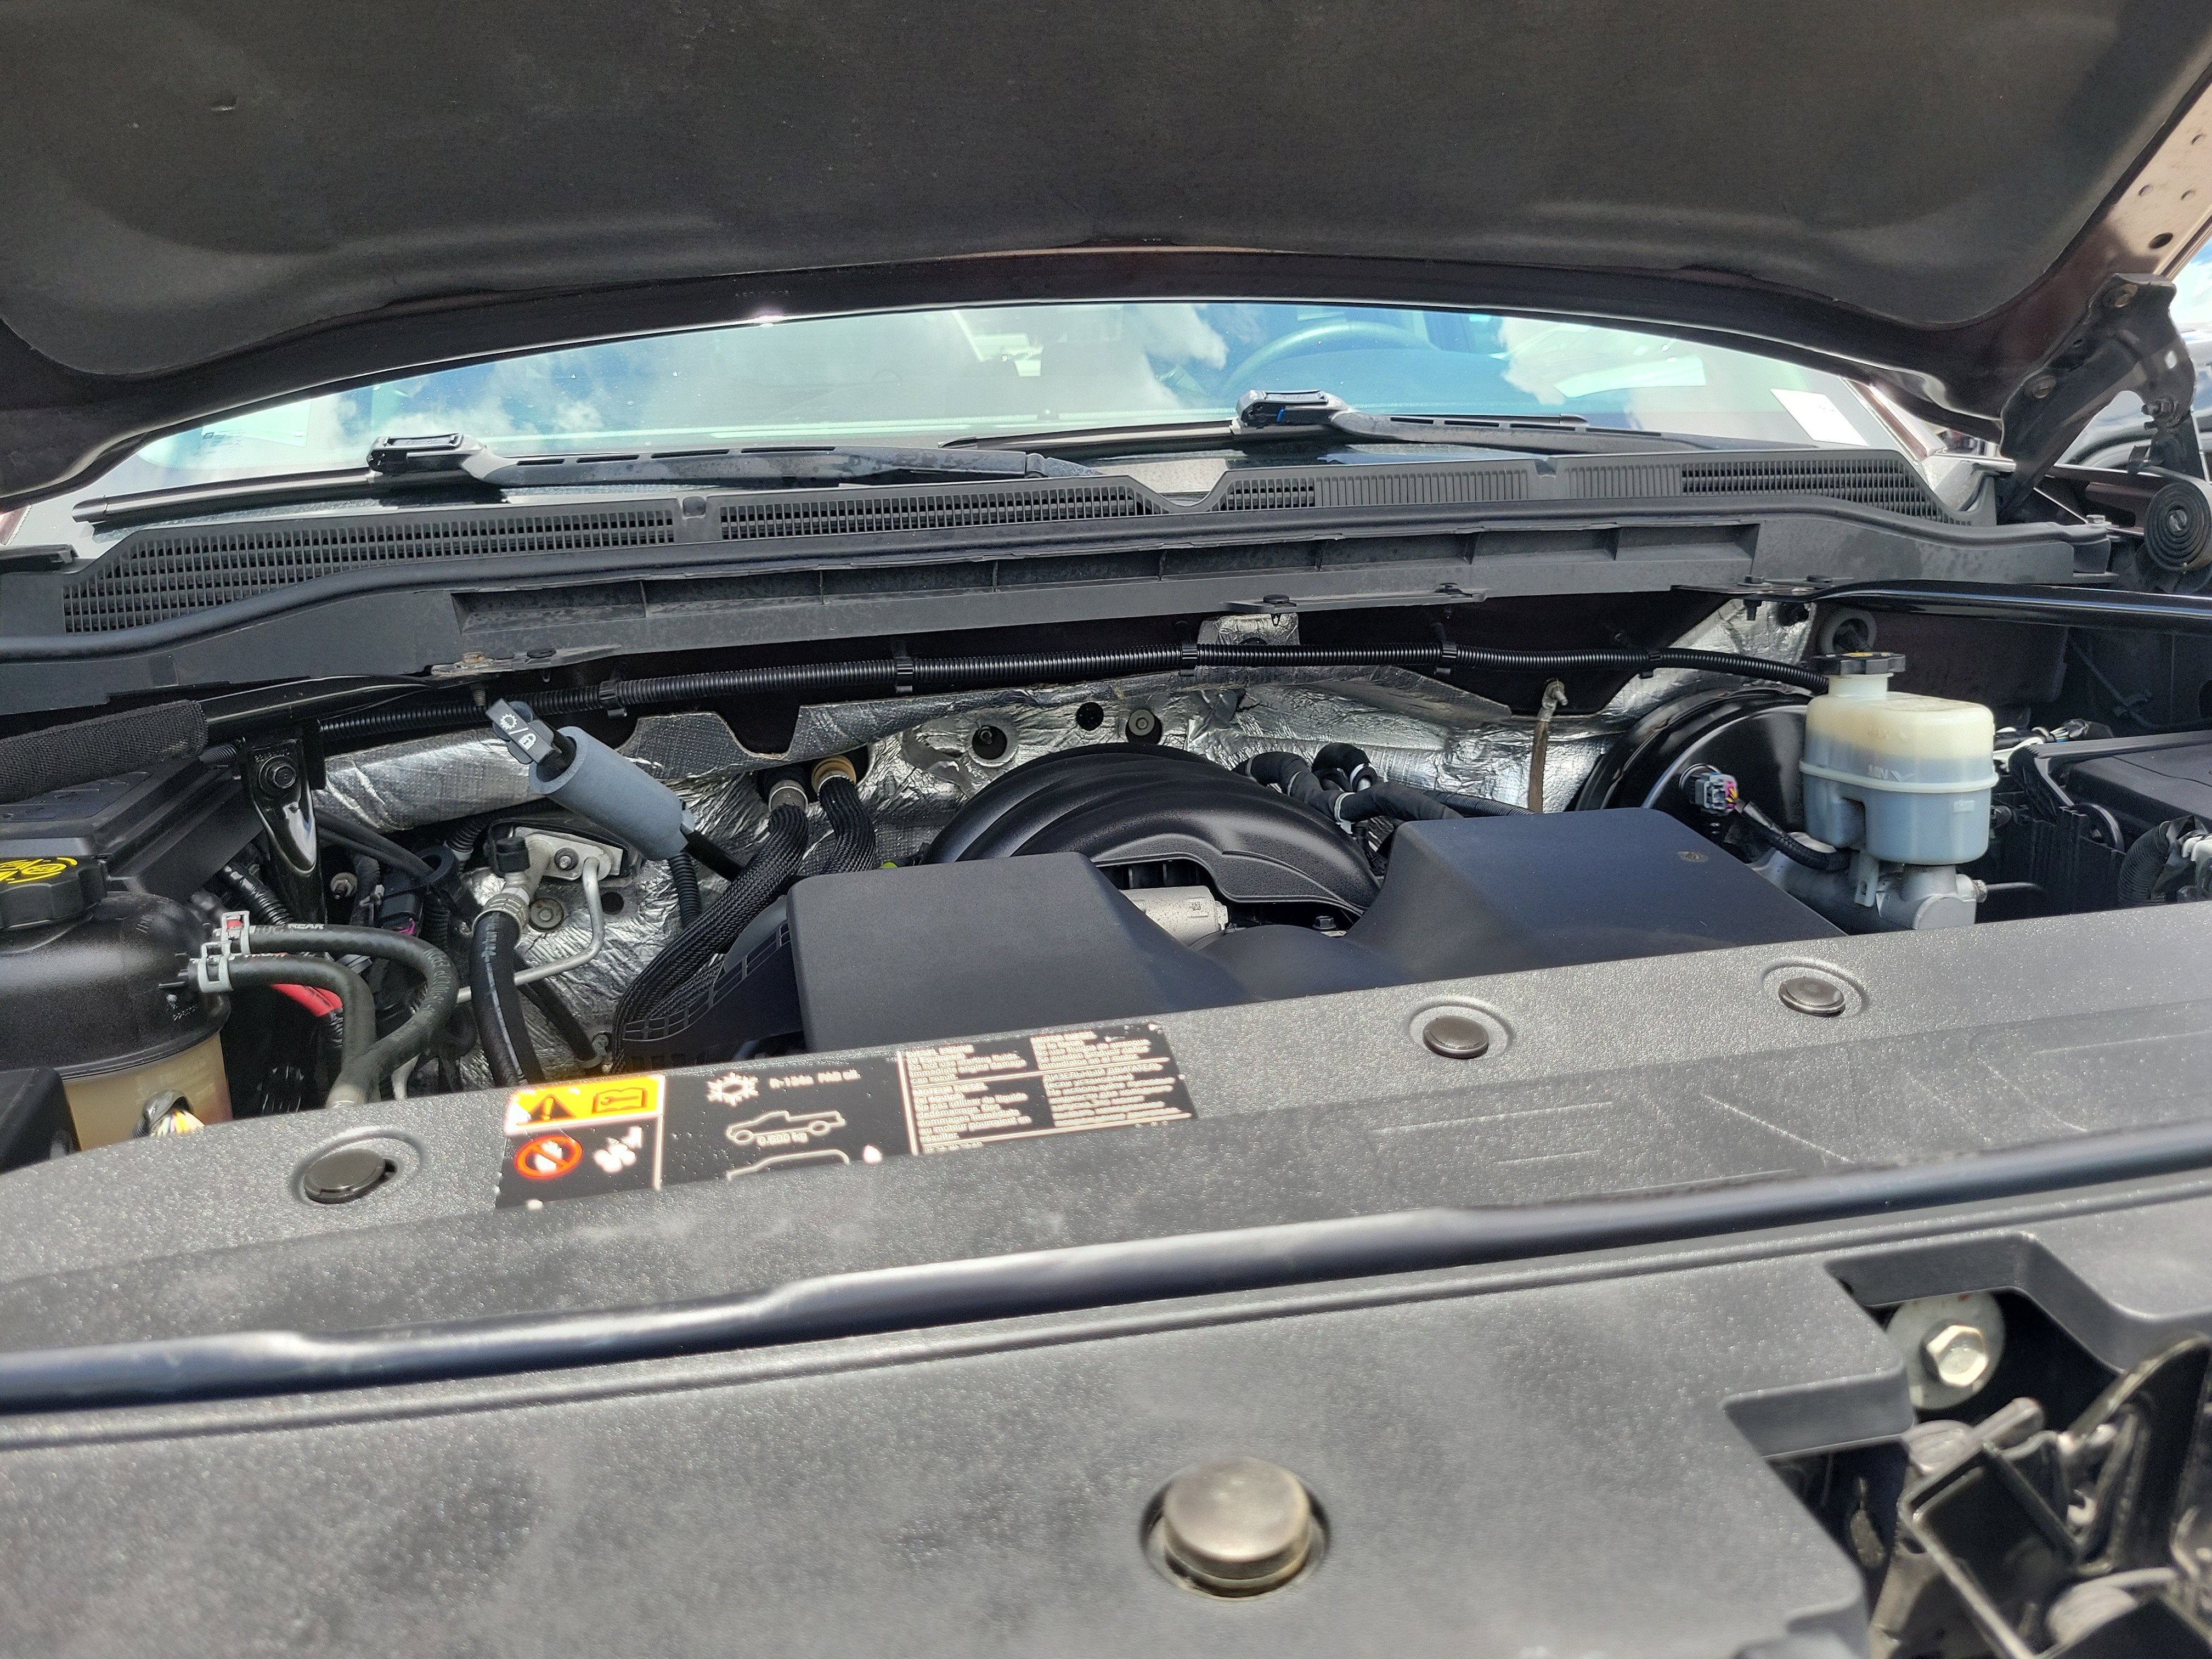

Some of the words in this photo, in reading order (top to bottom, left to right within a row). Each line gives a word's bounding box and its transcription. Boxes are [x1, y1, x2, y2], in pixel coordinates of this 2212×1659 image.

[1031, 1035, 1064, 1043] MOTOR
[906, 1048, 938, 1058] DIESEL
[939, 1044, 974, 1054] ENGINE
[1050, 1052, 1084, 1062] pueden
[1084, 1049, 1121, 1059] producir
[1066, 1045, 1096, 1053] fluidos
[957, 1056, 991, 1066] starting
[958, 1063, 989, 1073] engine
[990, 1058, 1026, 1069] damage
[930, 1073, 958, 1082] result.
[1042, 1068, 1105, 1081] ДИЗЕЛЬНЫЙ
[1105, 1063, 1163, 1075] ДВИГАТЕЛЬ
[913, 1086, 952, 1097] MOTEUR
[953, 1081, 988, 1092] DIESEL
[930, 1102, 948, 1110] pas
[949, 1097, 981, 1107] utiliser
[995, 1092, 1027, 1103] liquide
[918, 1114, 970, 1128] dommages
[933, 1123, 968, 1133] moteur
[968, 1116, 1017, 1130] pourraient
[757, 1133, 790, 1146] 0.600
[791, 1132, 808, 1142] kg
[921, 1132, 959, 1142] résulter.
